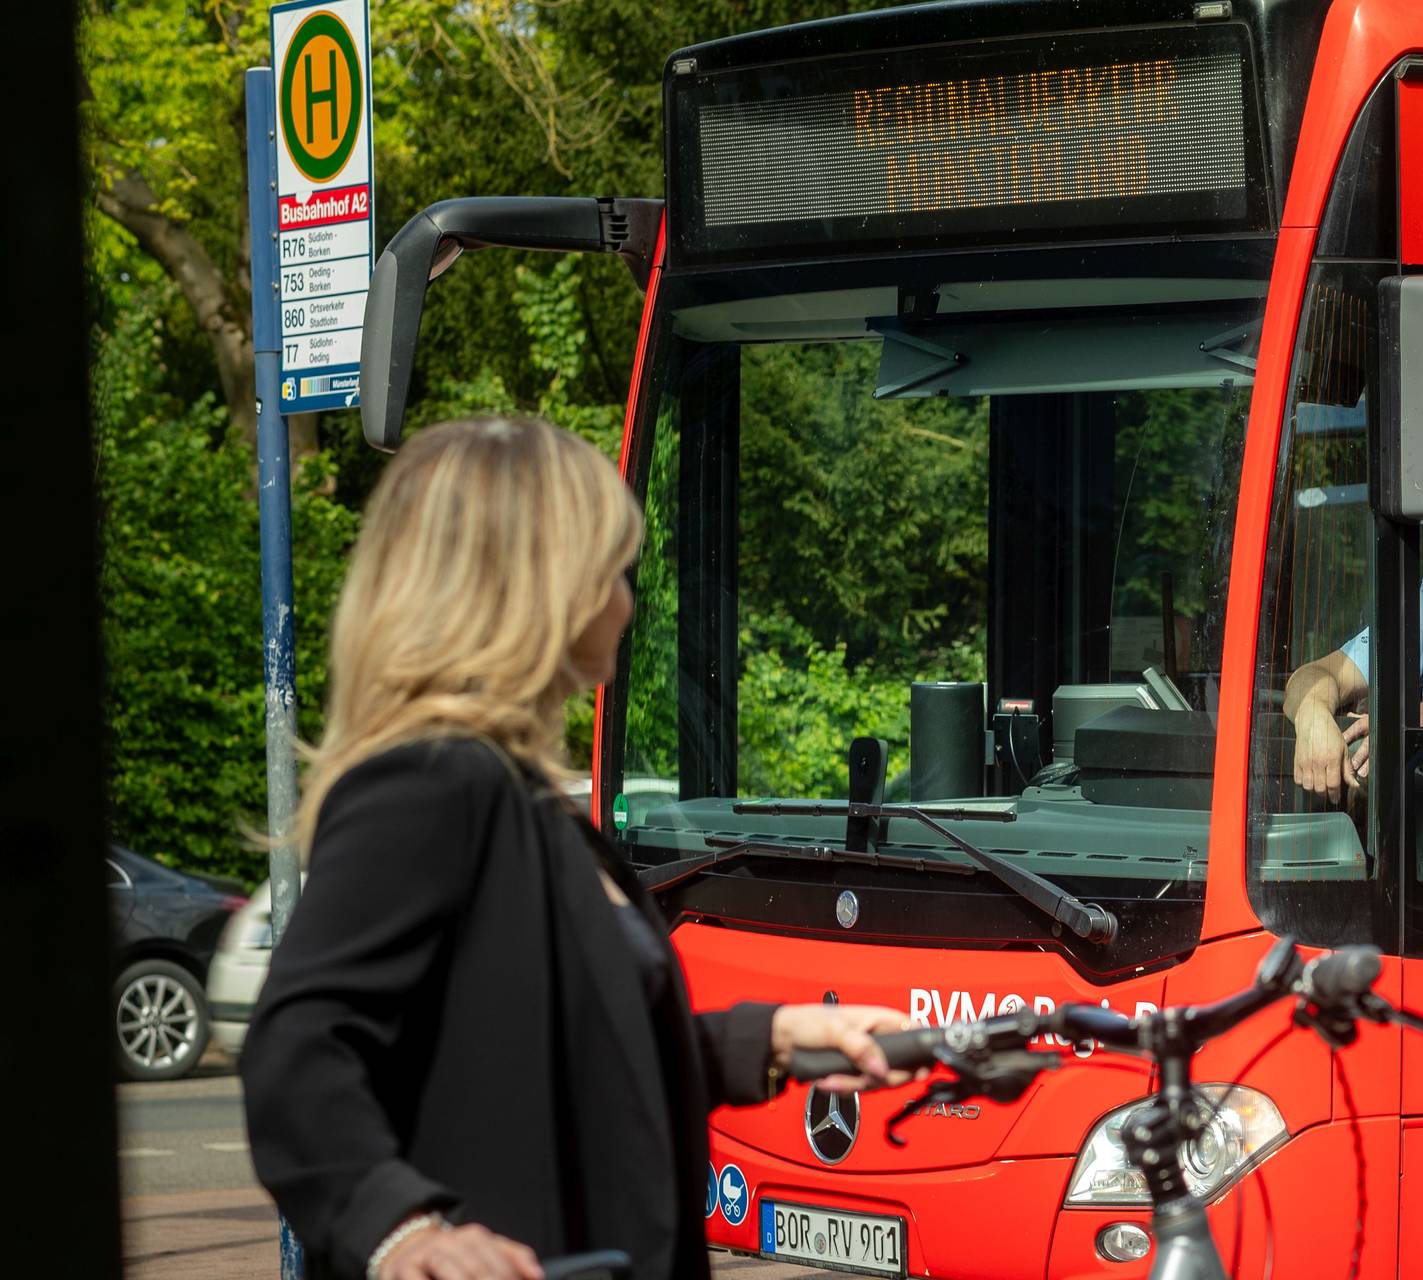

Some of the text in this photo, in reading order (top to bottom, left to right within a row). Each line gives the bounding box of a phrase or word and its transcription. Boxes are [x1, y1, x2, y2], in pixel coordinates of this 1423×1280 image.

[305, 49, 338, 144] H
[854, 60, 1180, 148] REGIONALVERKEHR
[281, 191, 367, 225] Busbahnhof A2
[308, 231, 333, 243] Südlohn
[283, 237, 306, 259] R76
[308, 247, 330, 258] Borken
[309, 267, 331, 278] Oeding
[283, 272, 304, 293] 753
[309, 282, 331, 293] Borken
[309, 300, 345, 314] Ortsverkehr
[284, 307, 305, 329] 860
[310, 316, 338, 328] Stadtlohn
[309, 337, 334, 349] Südlohn
[285, 344, 299, 363] T7
[309, 352, 330, 364] Oeding
[905, 1099, 981, 1120] TARO
[775, 1210, 811, 1250] BOR
[828, 1218, 853, 1257] RV
[860, 1223, 899, 1265] 901
